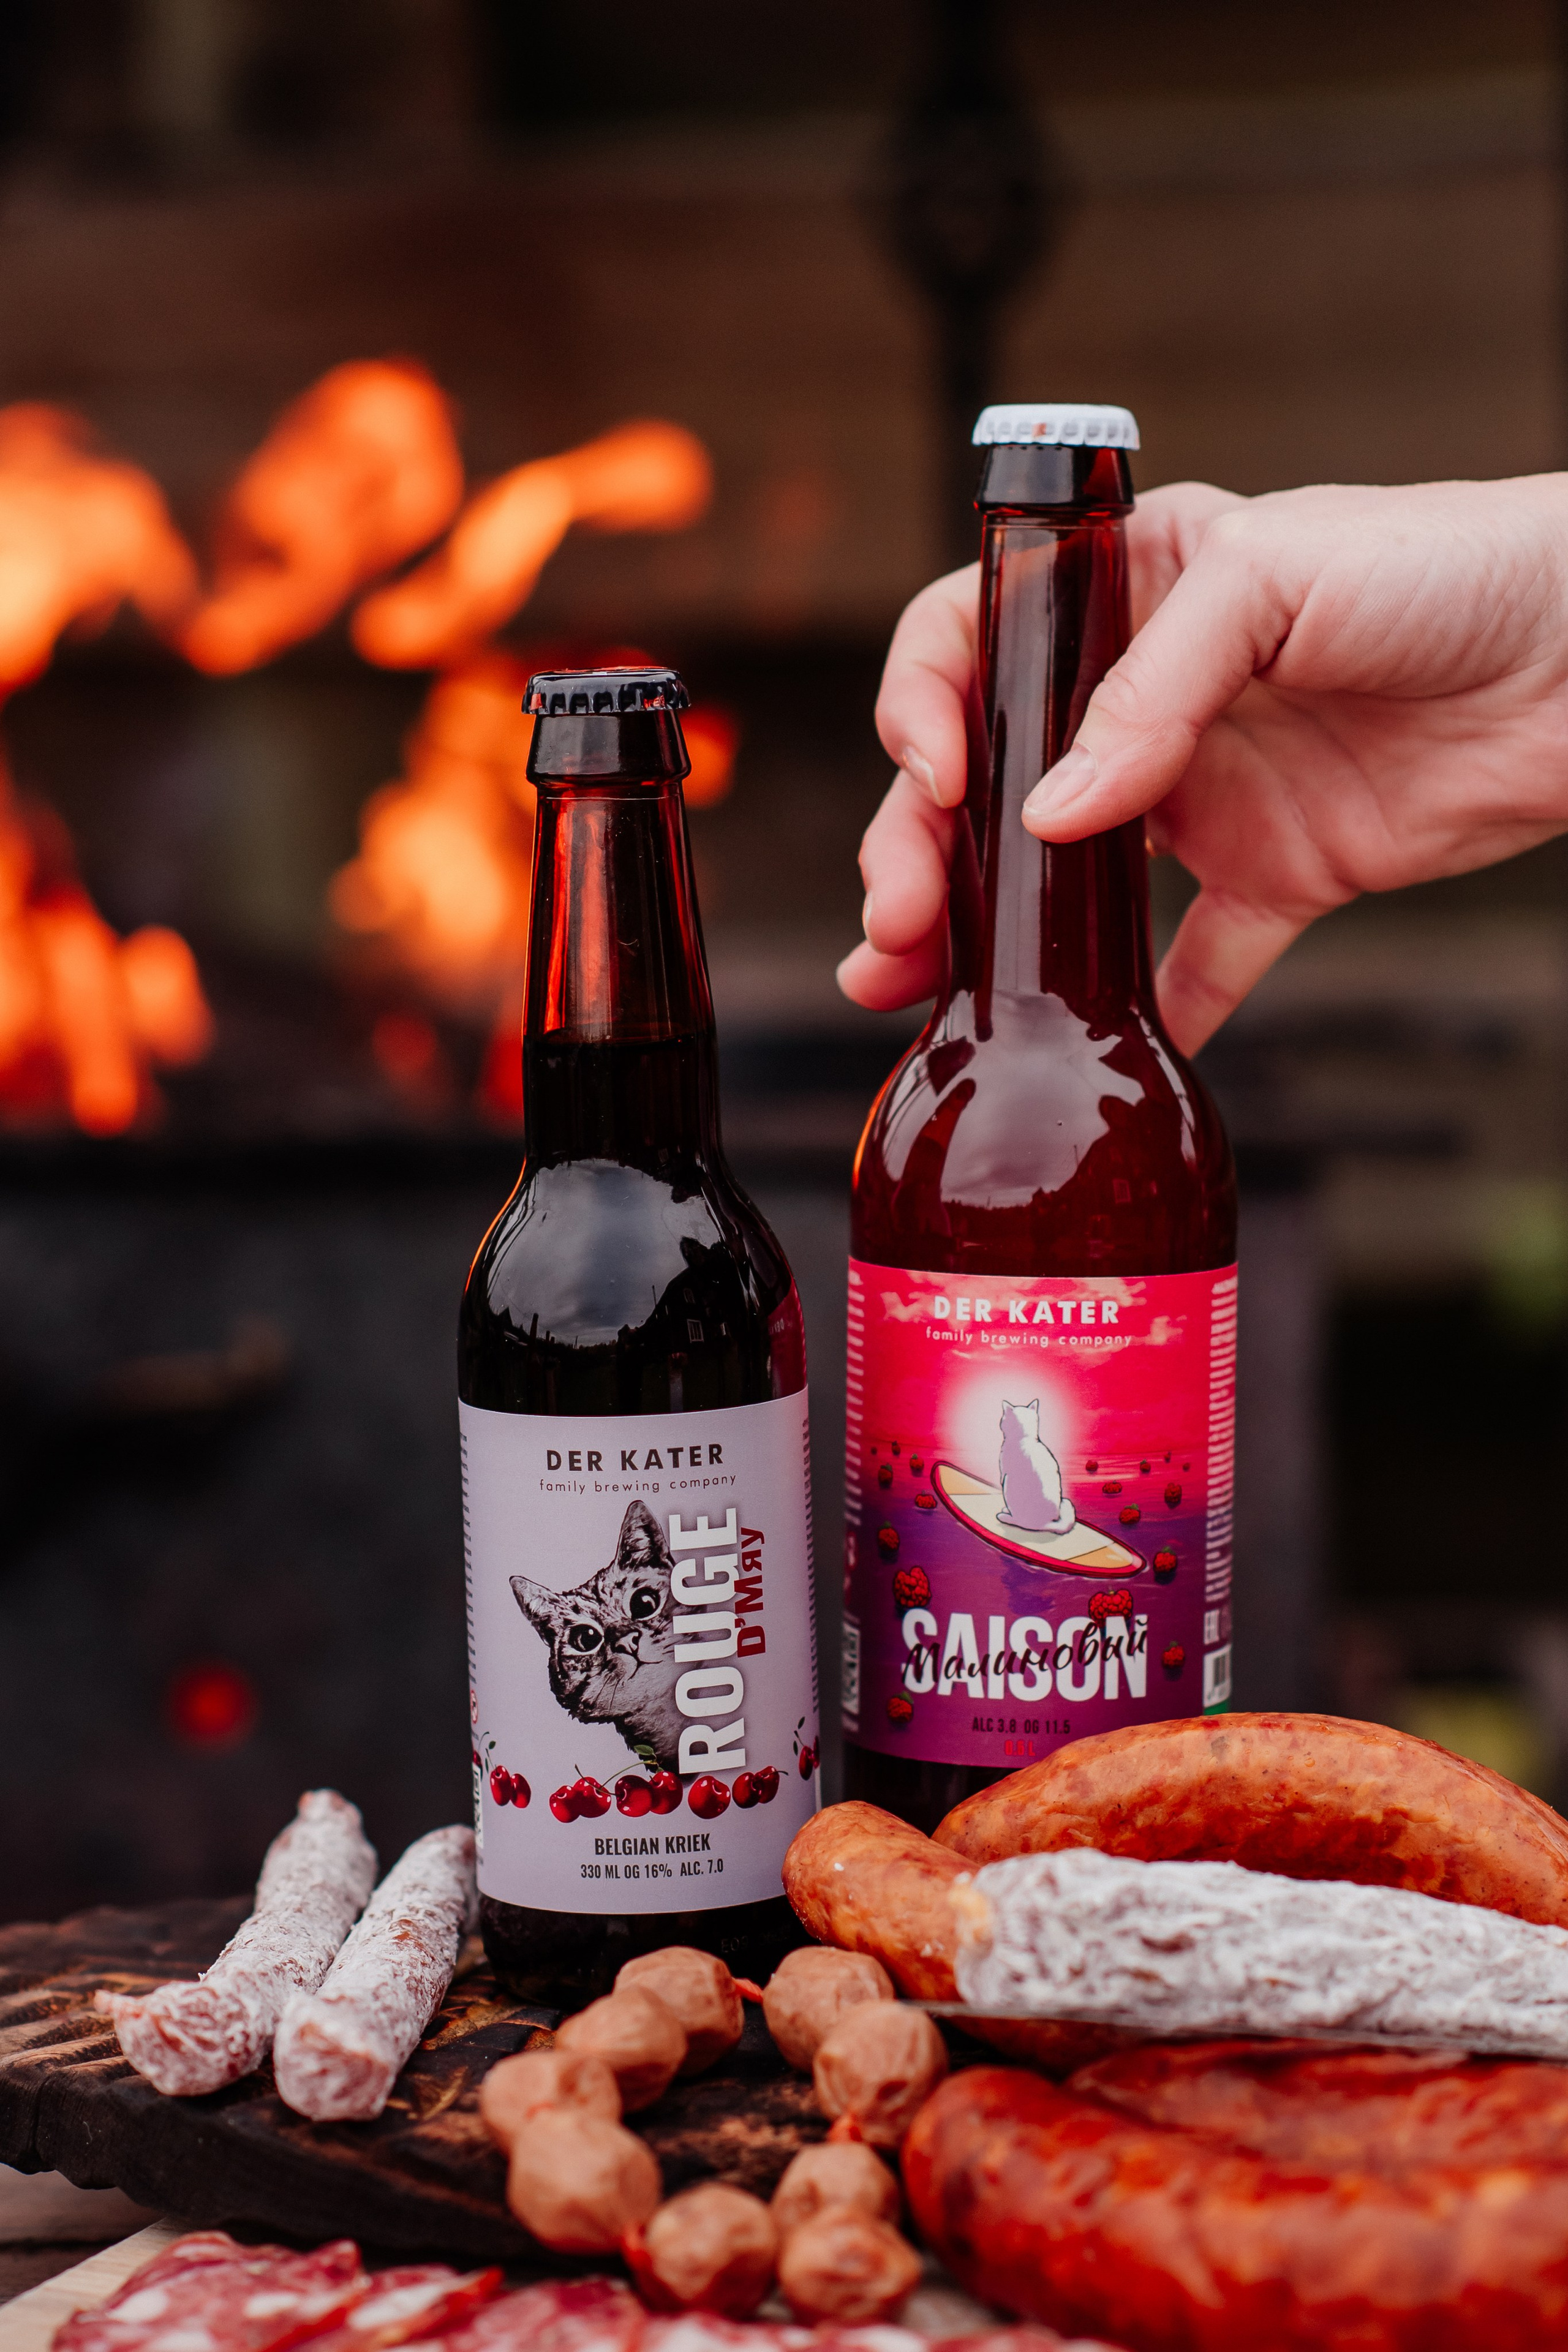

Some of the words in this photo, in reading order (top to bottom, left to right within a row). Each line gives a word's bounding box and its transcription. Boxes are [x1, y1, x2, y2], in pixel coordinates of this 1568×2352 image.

[934, 1295, 992, 1322] DER
[1008, 1300, 1120, 1324] KATER
[925, 1326, 973, 1345] family
[981, 1330, 1049, 1348] brewing
[1058, 1335, 1133, 1349] company
[546, 1449, 604, 1471] DER
[620, 1443, 724, 1471] KATER
[539, 1479, 586, 1494] family
[594, 1479, 660, 1493] brewing
[669, 1474, 736, 1490] company
[668, 1507, 747, 1774] ROUGE
[901, 1617, 1149, 1684] Малиновый
[900, 1607, 1148, 1702] SAISON
[972, 1717, 993, 1732] ALC
[997, 1718, 1017, 1733] 3.8
[1024, 1719, 1039, 1734] OG
[1045, 1720, 1071, 1735] 11.5
[1028, 1740, 1036, 1757] L
[594, 1837, 660, 1855] BELGIAN
[665, 1833, 711, 1854] KRIEK
[580, 1863, 601, 1879] 330
[605, 1864, 620, 1879] ML
[624, 1864, 640, 1879] OG
[644, 1863, 673, 1879] 16%
[680, 1861, 704, 1877] ALC.
[707, 1858, 724, 1874] 7.0
